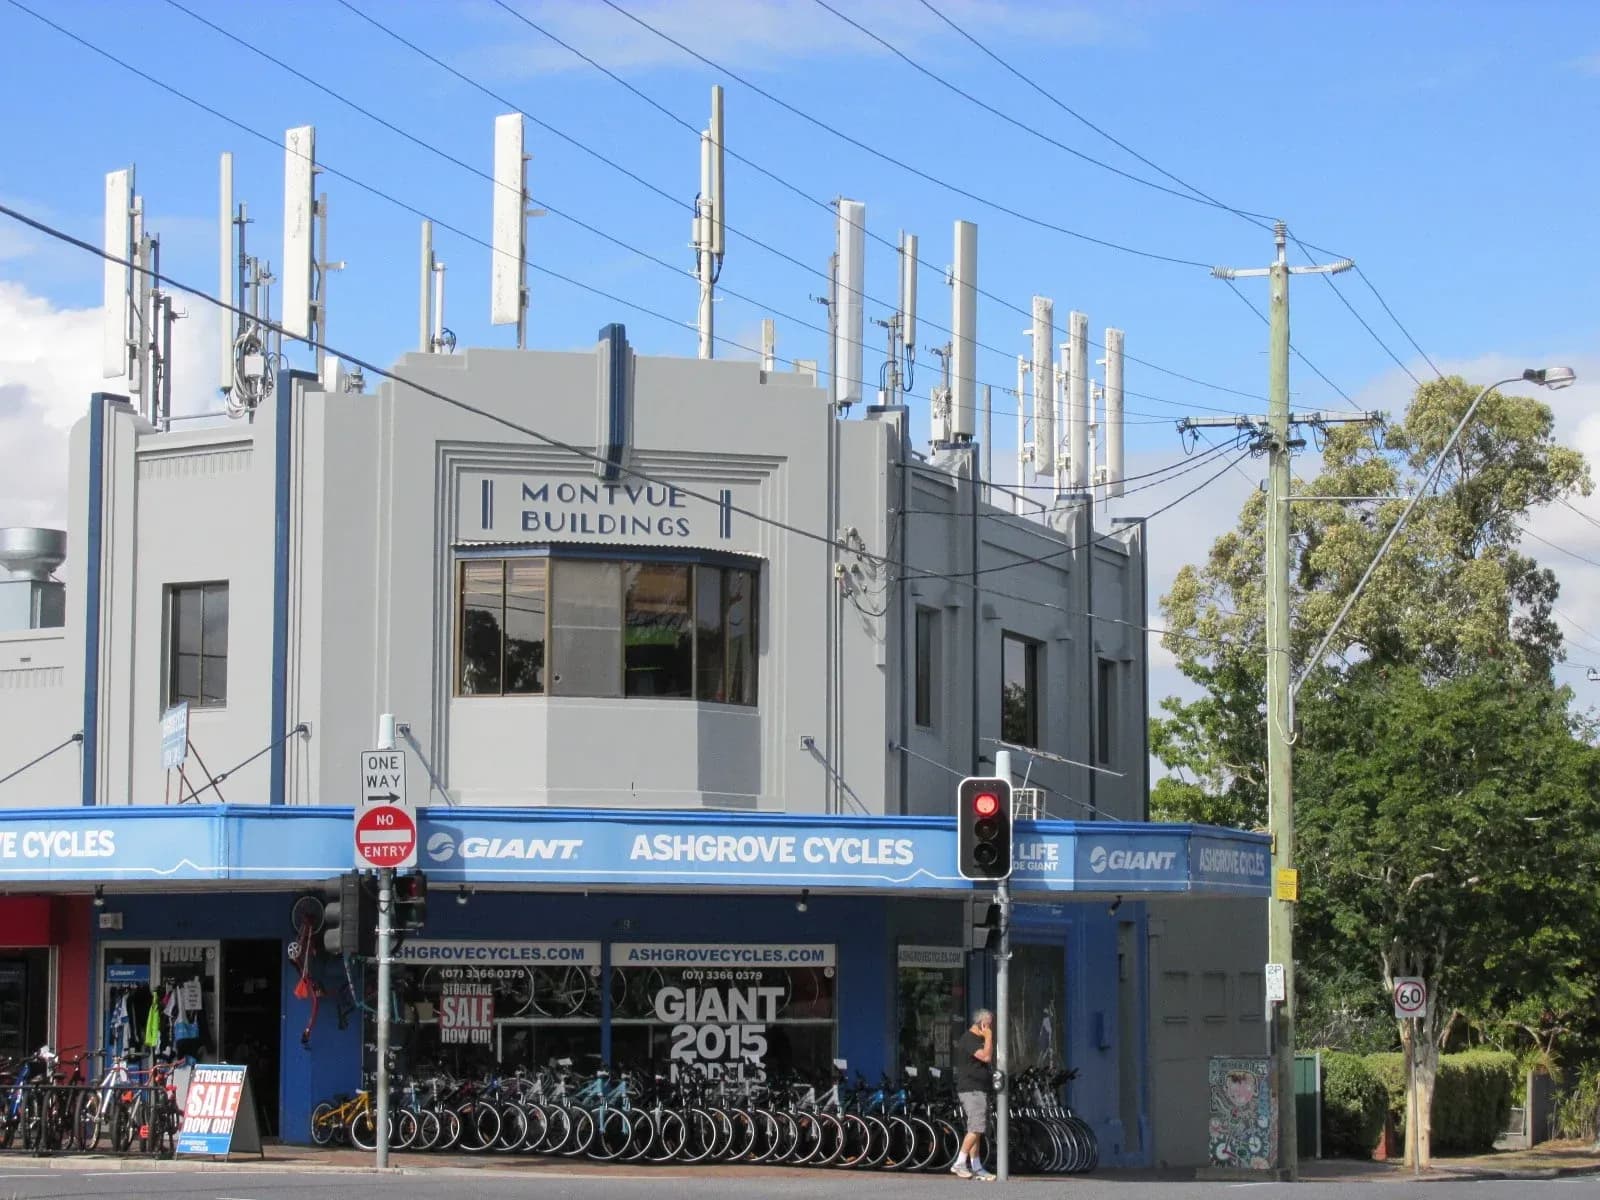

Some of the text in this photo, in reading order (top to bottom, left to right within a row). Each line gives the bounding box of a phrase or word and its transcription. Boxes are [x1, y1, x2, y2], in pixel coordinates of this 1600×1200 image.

[522, 481, 687, 508] MONTVUE
[521, 511, 691, 537] BUILDINGS
[368, 756, 399, 770] ONE
[366, 775, 401, 788] WAY
[376, 814, 394, 826] NO
[23, 829, 115, 858] CYCLES
[364, 846, 407, 857] ENTRY
[458, 837, 583, 859] GIANT
[630, 834, 914, 865] ASHGROVE CYCLES
[1019, 843, 1059, 861] LIFE
[1027, 861, 1058, 871] GIANT
[1108, 851, 1177, 870] GIANT
[1199, 847, 1265, 876] ASHGROVE CYCLES
[628, 948, 824, 962] ASHGROVECYCLES.COM
[441, 968, 464, 979] (07)
[496, 969, 525, 978] 0379
[682, 970, 763, 980] (07) 3366 0379
[442, 983, 493, 996] STOCKTAKE
[1400, 989, 1420, 1004] 60
[441, 997, 492, 1028] SALE
[655, 986, 785, 1023] GIANT
[670, 1024, 768, 1060] 2015
[194, 1069, 243, 1083] STOCKTAKE
[187, 1084, 240, 1117] SALE
